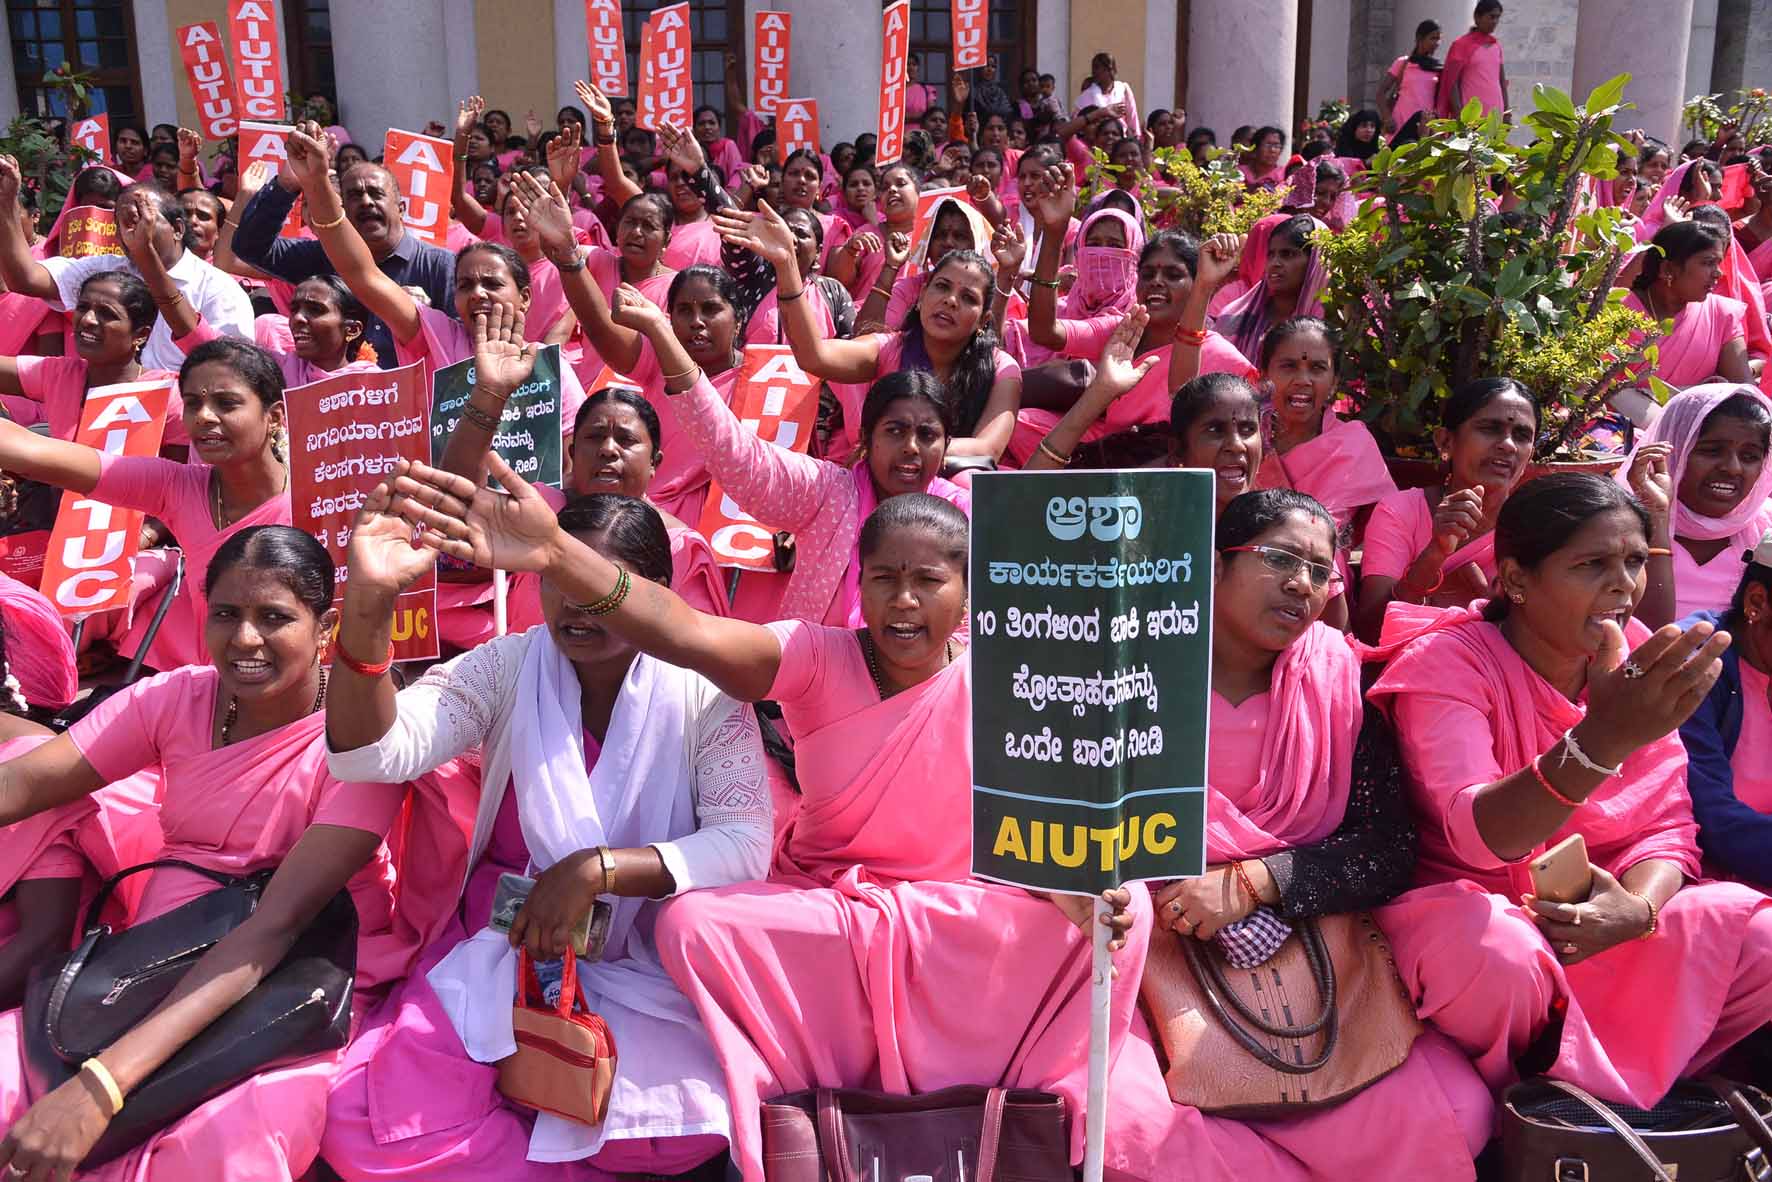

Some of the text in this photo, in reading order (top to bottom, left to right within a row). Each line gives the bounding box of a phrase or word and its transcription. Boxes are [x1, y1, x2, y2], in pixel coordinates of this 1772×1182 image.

[185, 25, 237, 137] AIUTUC
[235, 1, 277, 116] AIUTUC
[591, 0, 622, 94] AIUTUC
[657, 11, 686, 132] AIUTUC
[881, 9, 904, 157] AIUTUC
[306, 412, 423, 451] ನಿಗದಿಯಾಗಿರುವ
[56, 396, 152, 607] AITUC
[1046, 496, 1142, 541] ಆಶಾ
[977, 600, 1199, 643] 10 ತಿಂಗಳಿಂದ ಬಾಕಿ ಇರುವ
[1005, 726, 1063, 763] ಒಂದೇ
[1127, 725, 1163, 759] ನೀಡಿ
[993, 812, 1177, 872] AIUTUC
